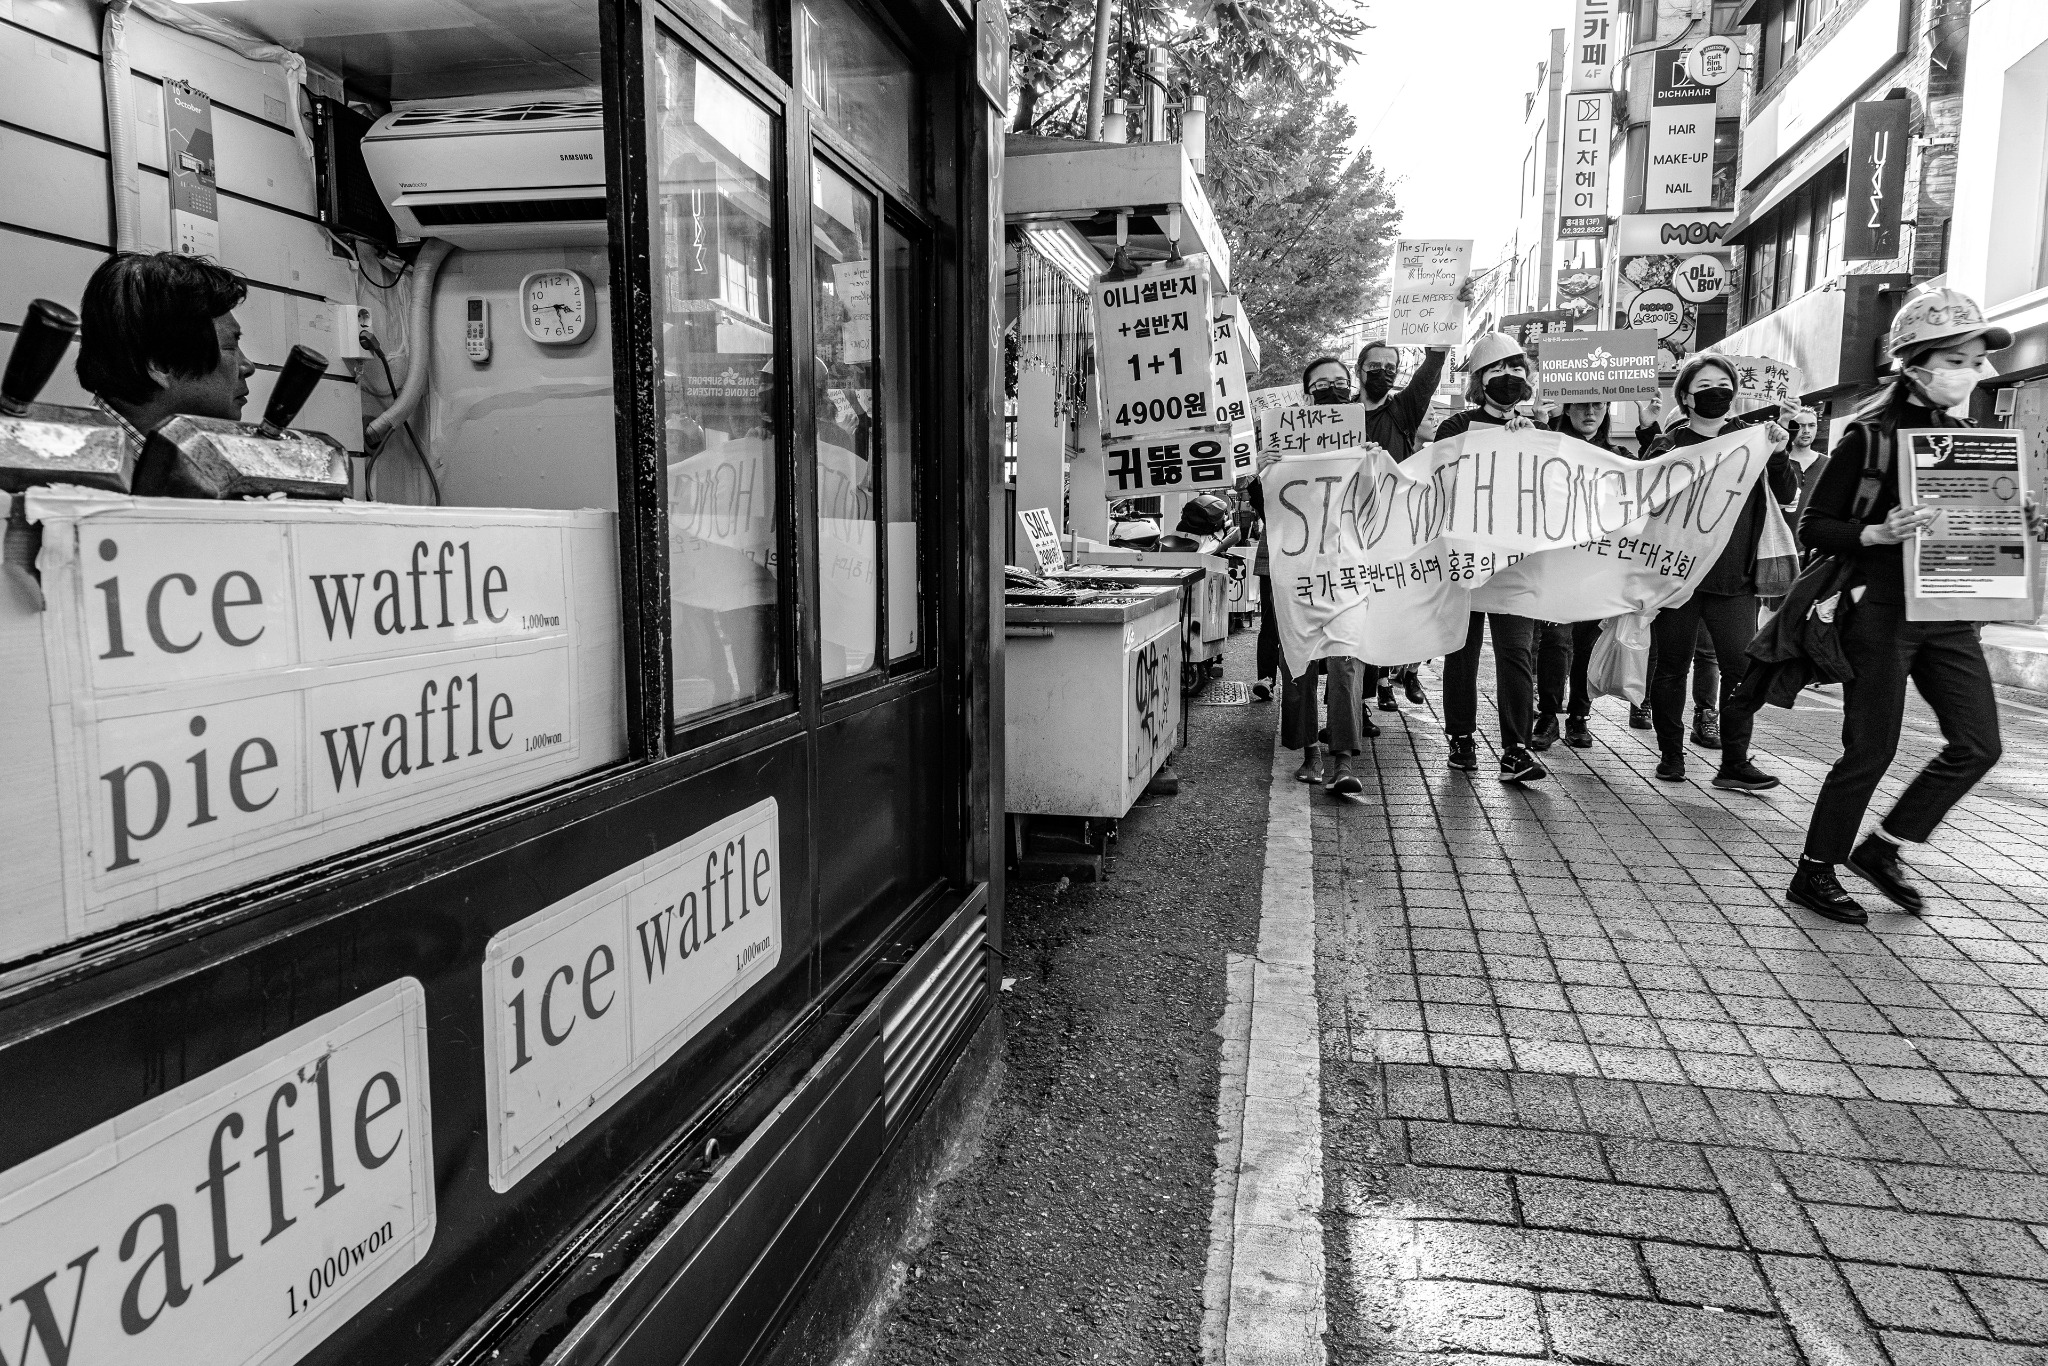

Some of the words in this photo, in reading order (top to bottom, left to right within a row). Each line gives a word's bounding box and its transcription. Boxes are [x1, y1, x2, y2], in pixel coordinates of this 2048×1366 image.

[1706, 53, 1721, 61] cult
[1585, 69, 1602, 79] 4F
[1658, 88, 1711, 98] DICHAHAIR
[174, 97, 202, 114] October
[1668, 124, 1696, 135] HAIR
[559, 153, 594, 161] SAMSUNG
[1653, 152, 1708, 165] MAKE-UP
[1665, 183, 1692, 194] NAIL
[1690, 264, 1715, 280] OLD
[539, 281, 548, 289] 11
[550, 277, 561, 286] 12
[566, 278, 570, 286] 1
[1697, 278, 1722, 292] BOY
[532, 291, 543, 300] 10
[1103, 275, 1197, 308] 이니셜반지
[1393, 309, 1411, 318] OUT
[1640, 302, 1673, 312] MOMO
[535, 318, 541, 326] 8
[1401, 322, 1429, 335] HONG
[1433, 321, 1458, 333] KONG
[544, 328, 550, 336] 7
[556, 327, 562, 336] 6
[568, 326, 574, 334] 5
[1127, 347, 1183, 381] 1+1
[1542, 359, 1588, 370] KOREANS
[1609, 356, 1655, 367] SUPPORT
[1542, 372, 1572, 383] HONG
[1575, 371, 1604, 382] KONG
[1608, 369, 1655, 380] CITIZENS
[1543, 388, 1559, 397] Five
[1561, 387, 1600, 397] Demands,
[1602, 386, 1617, 395] Not
[1619, 385, 1635, 394] One
[1637, 385, 1655, 394] Less
[1115, 391, 1207, 427] 4900원
[1280, 408, 1344, 431] 시위자는
[1268, 432, 1310, 453] 폭도가
[1316, 430, 1362, 449] 아니다!
[1108, 440, 1226, 490] 귀뚫음
[1025, 510, 1054, 539] SALE
[94, 538, 266, 661] ice
[308, 540, 510, 642] waffle
[521, 612, 560, 630] 1,000won
[100, 715, 279, 872] pie
[320, 673, 514, 794] waffle
[525, 731, 563, 753] 1,000won
[507, 941, 617, 1075] ice
[636, 834, 773, 986] waffle
[735, 934, 771, 972] 1,000won
[0, 1053, 404, 1366] waffle
[286, 1218, 395, 1320] 1,000won
